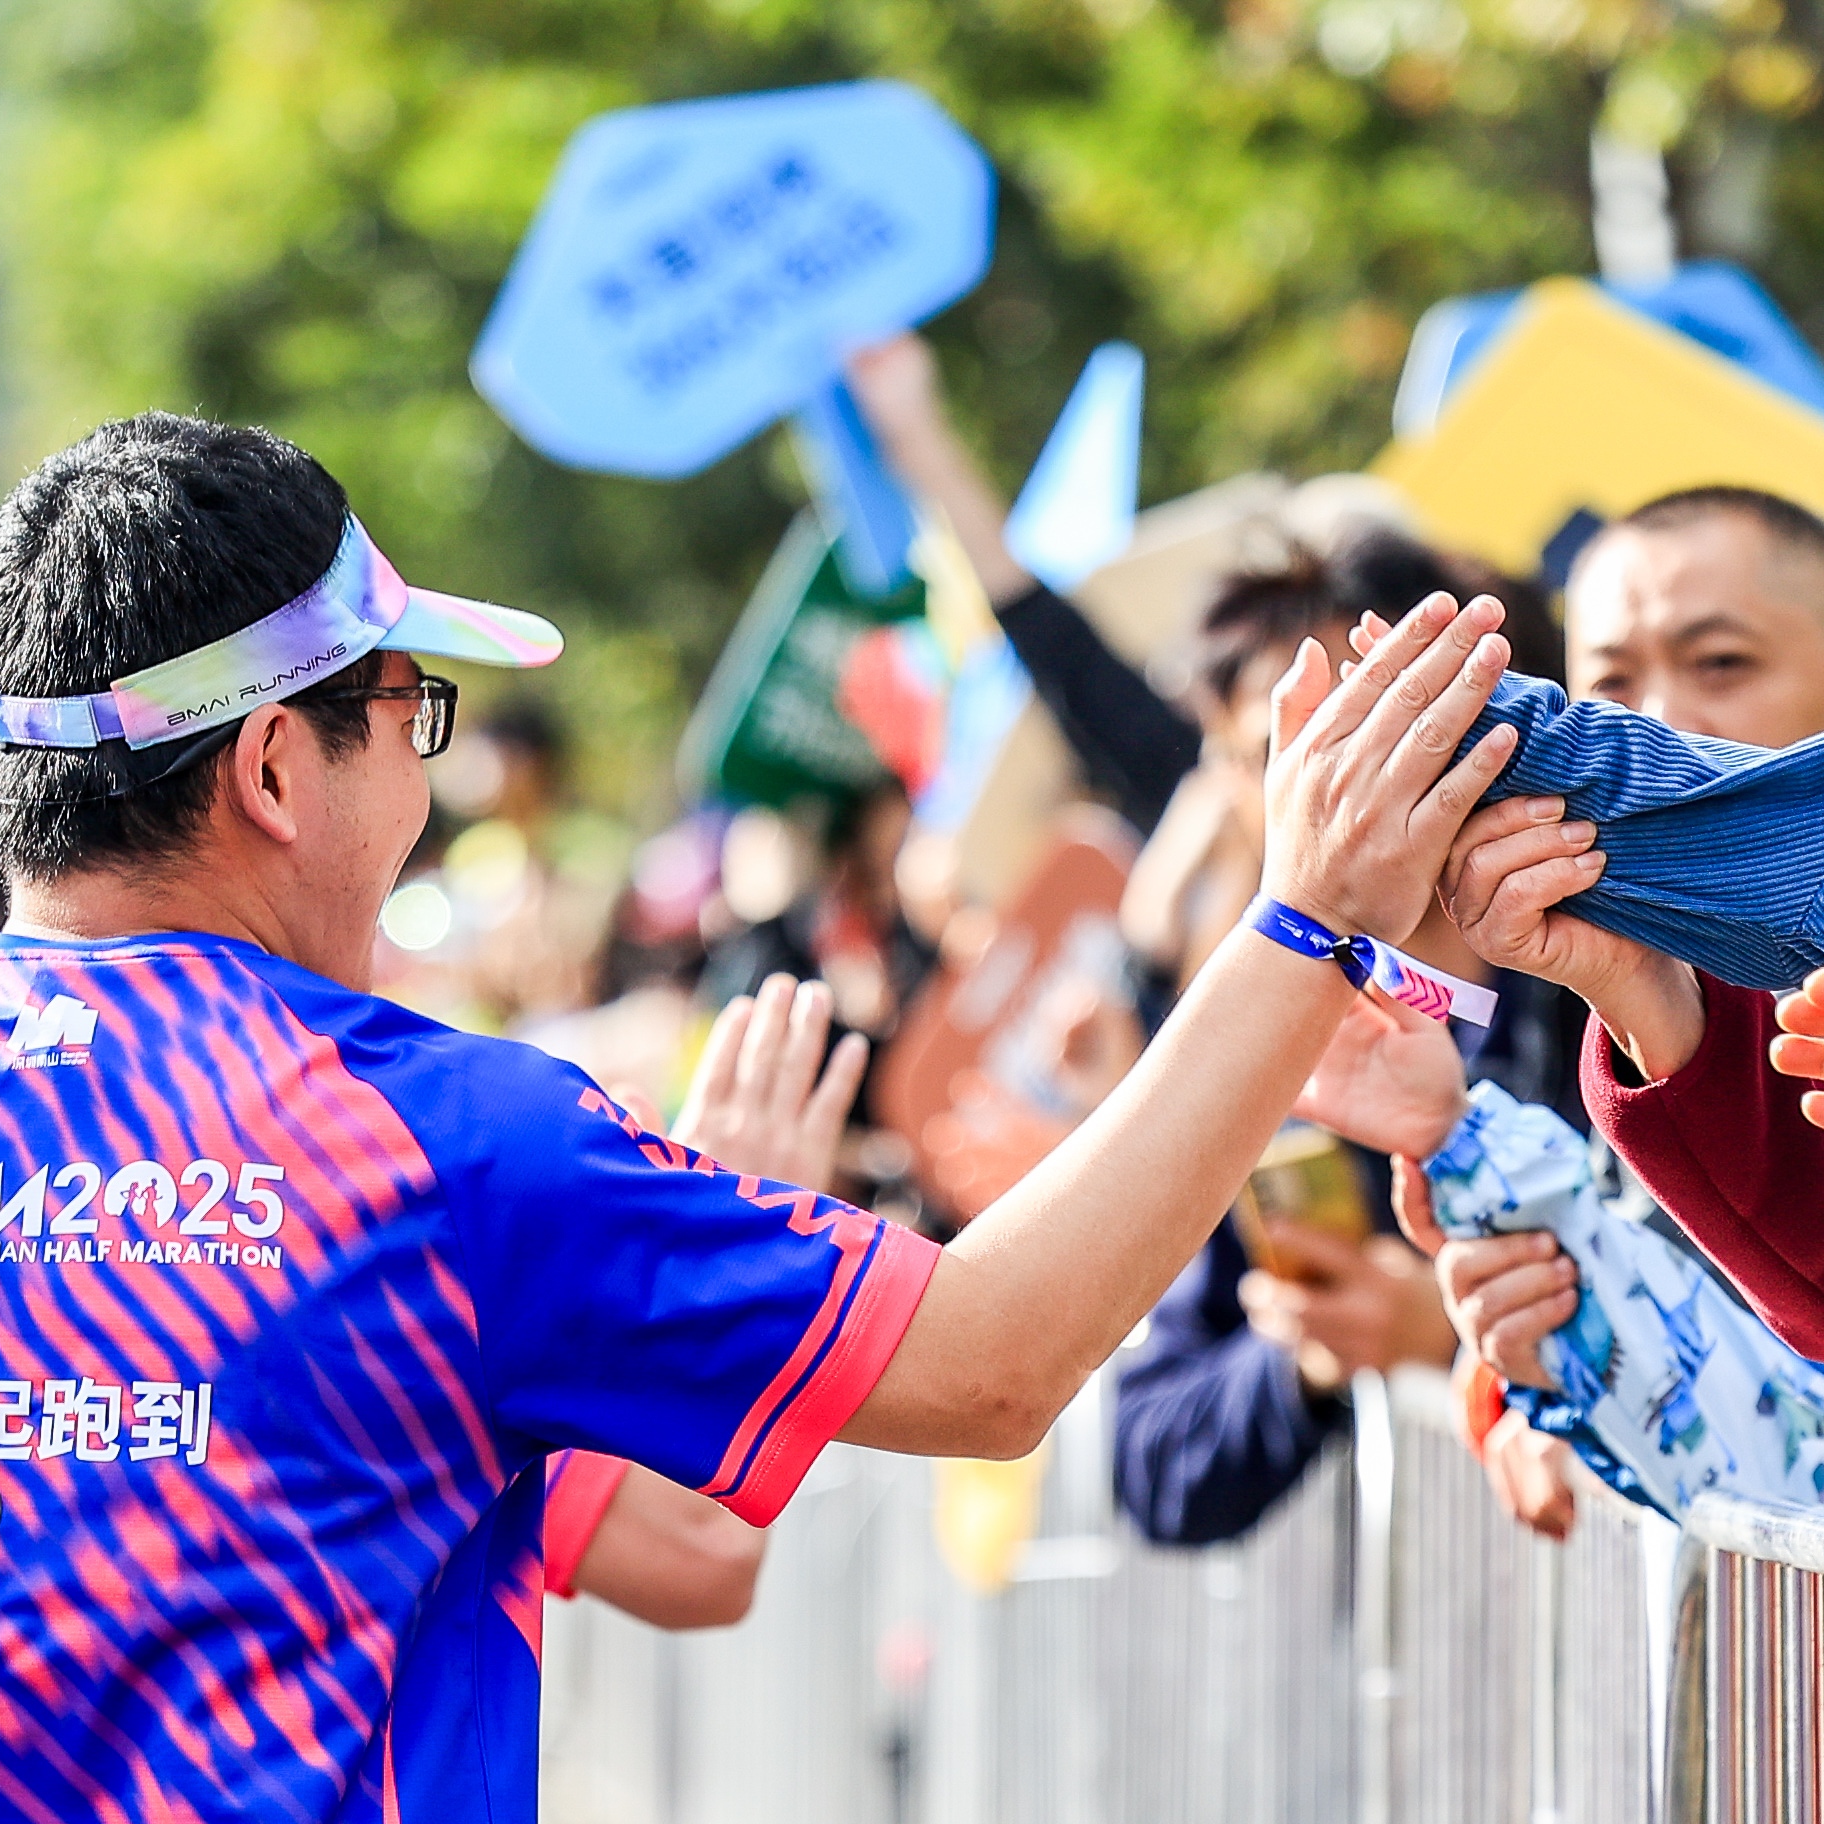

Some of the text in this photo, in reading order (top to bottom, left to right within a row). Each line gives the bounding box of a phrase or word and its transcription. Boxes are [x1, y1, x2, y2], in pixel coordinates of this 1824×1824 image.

[239, 642, 347, 699] RUNNING
[43, 1240, 114, 1263] HALF
[120, 1241, 283, 1270] MARATHON
